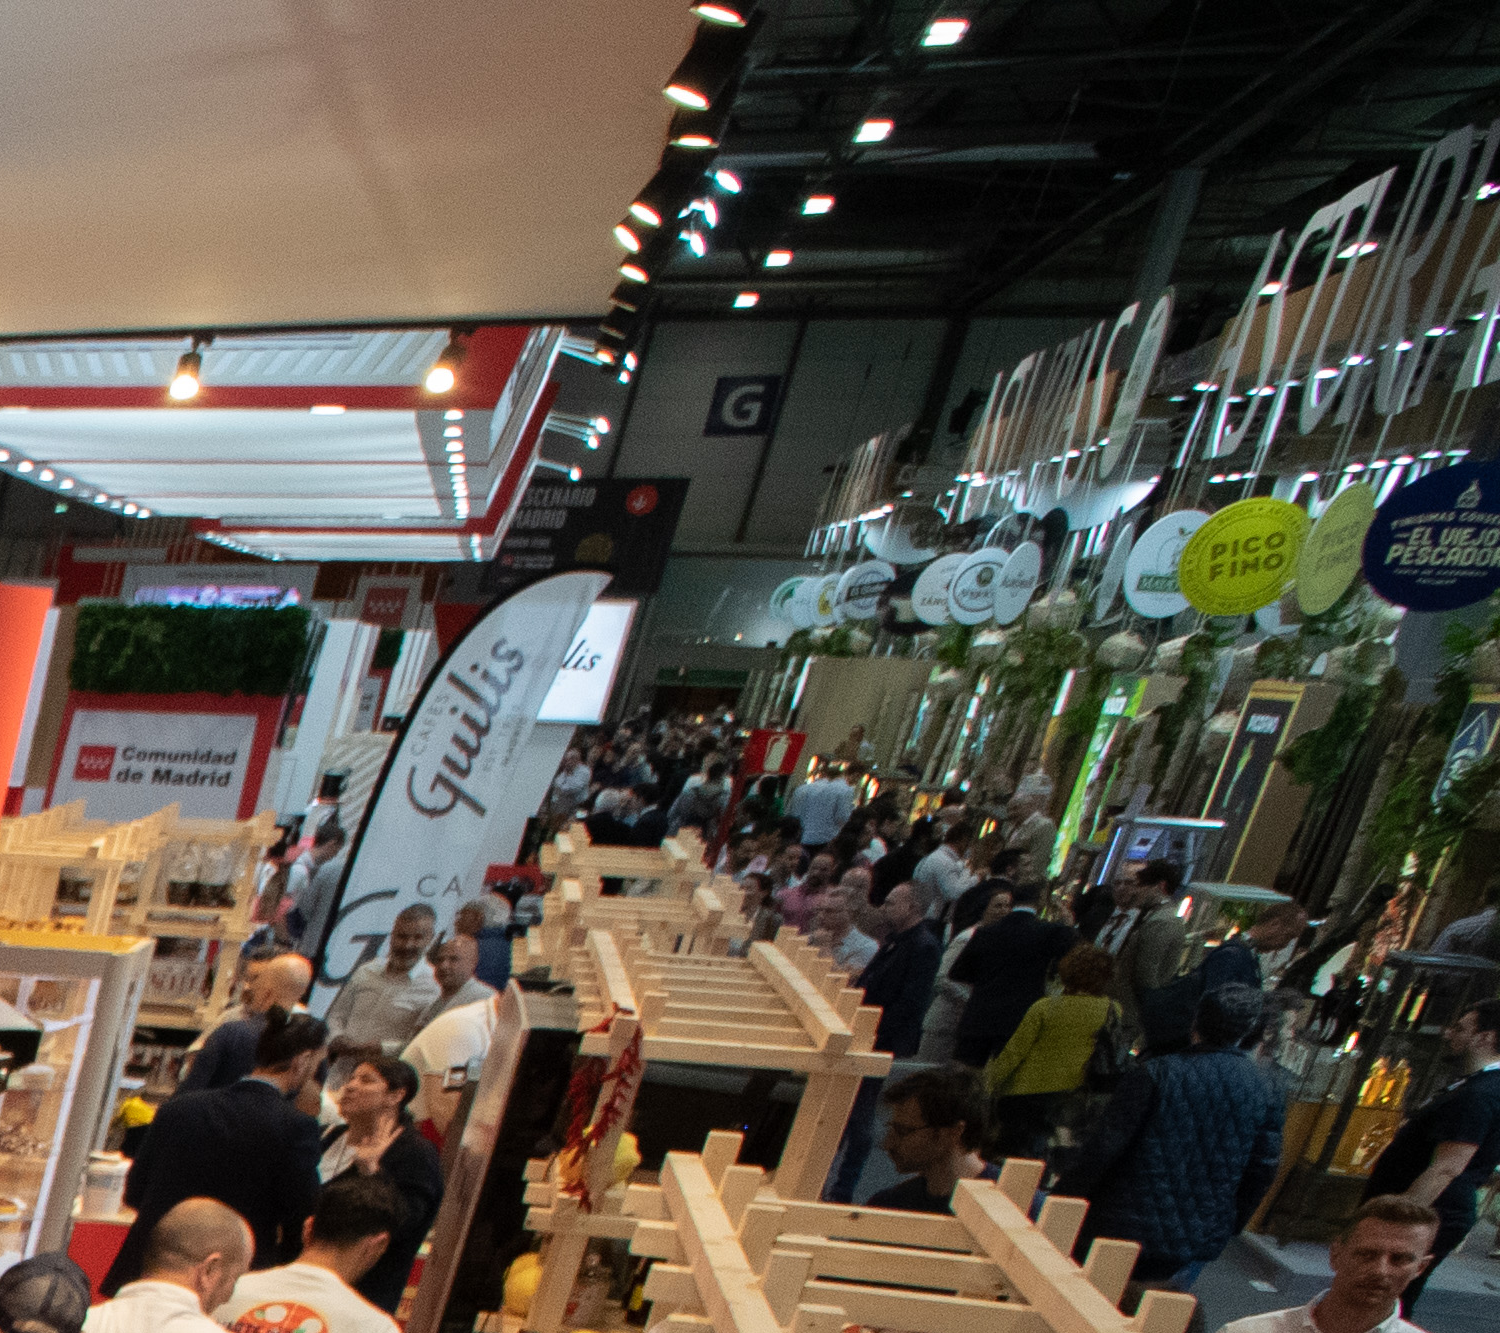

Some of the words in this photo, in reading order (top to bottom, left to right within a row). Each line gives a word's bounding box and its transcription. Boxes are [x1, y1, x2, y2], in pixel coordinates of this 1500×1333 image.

[718, 382, 766, 428] G
[1209, 531, 1286, 562] PICO
[1407, 528, 1432, 547] EL
[1438, 524, 1499, 548] VIEJO
[1208, 551, 1285, 583] FINO
[120, 746, 238, 766] Comunidad
[115, 768, 144, 785] de
[150, 768, 232, 789] Madrid
